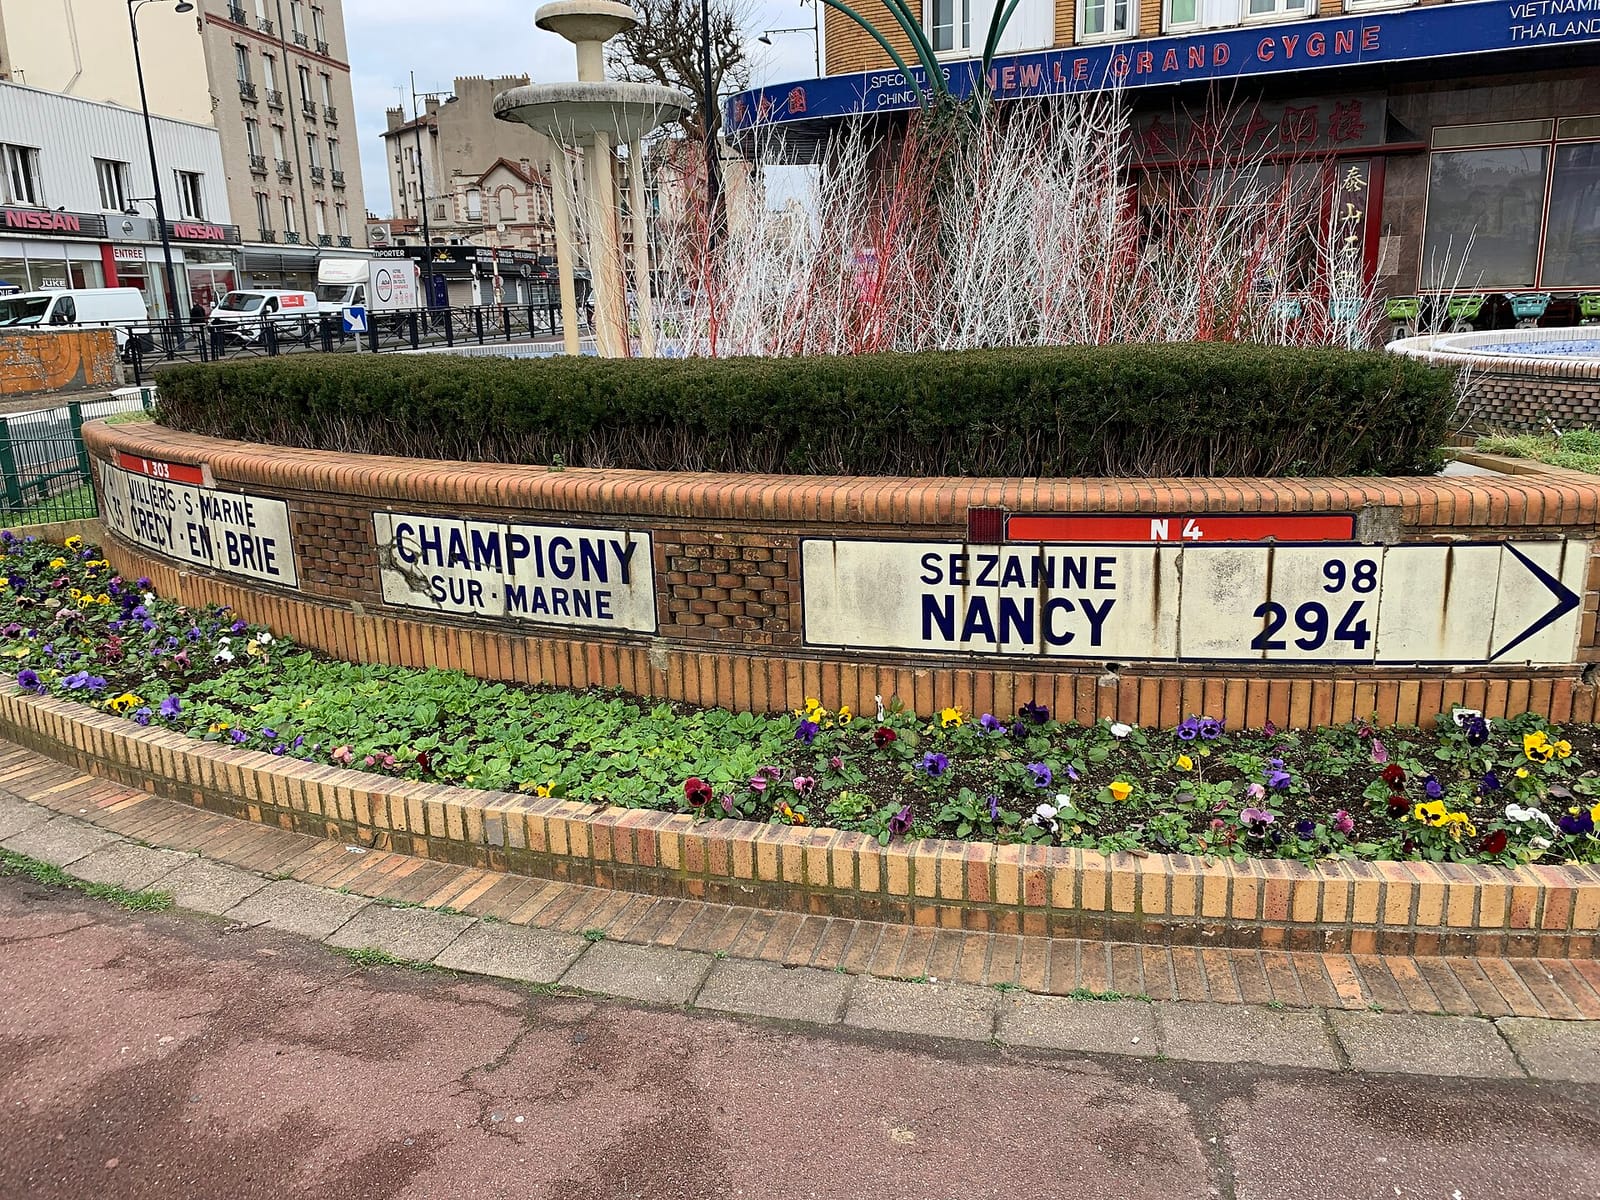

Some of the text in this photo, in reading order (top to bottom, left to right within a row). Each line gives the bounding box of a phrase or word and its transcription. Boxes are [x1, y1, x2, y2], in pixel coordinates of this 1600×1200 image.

[1510, 0, 1600, 19] VIETNAMI
[985, 25, 1380, 91] NEW LE GRAND CYGNE
[871, 67, 952, 88] SPECILIS
[5, 209, 81, 231] NISSAN
[173, 223, 225, 240] NISSAN
[114, 246, 144, 259] ENTRÉE
[373, 249, 405, 257] MPORTER
[152, 461, 170, 479] 303
[129, 479, 176, 512] VILLIERS
[200, 494, 257, 529] MARNE
[130, 504, 174, 550] CRECY
[186, 521, 215, 562] EN
[225, 530, 280, 576] BRIE
[1151, 518, 1203, 541] N 4
[396, 522, 638, 585] CHAMPIGNY
[919, 552, 1378, 594] SEZANNE 98
[431, 574, 614, 620] SUR MARNE
[920, 593, 1372, 651] NANCY 294
